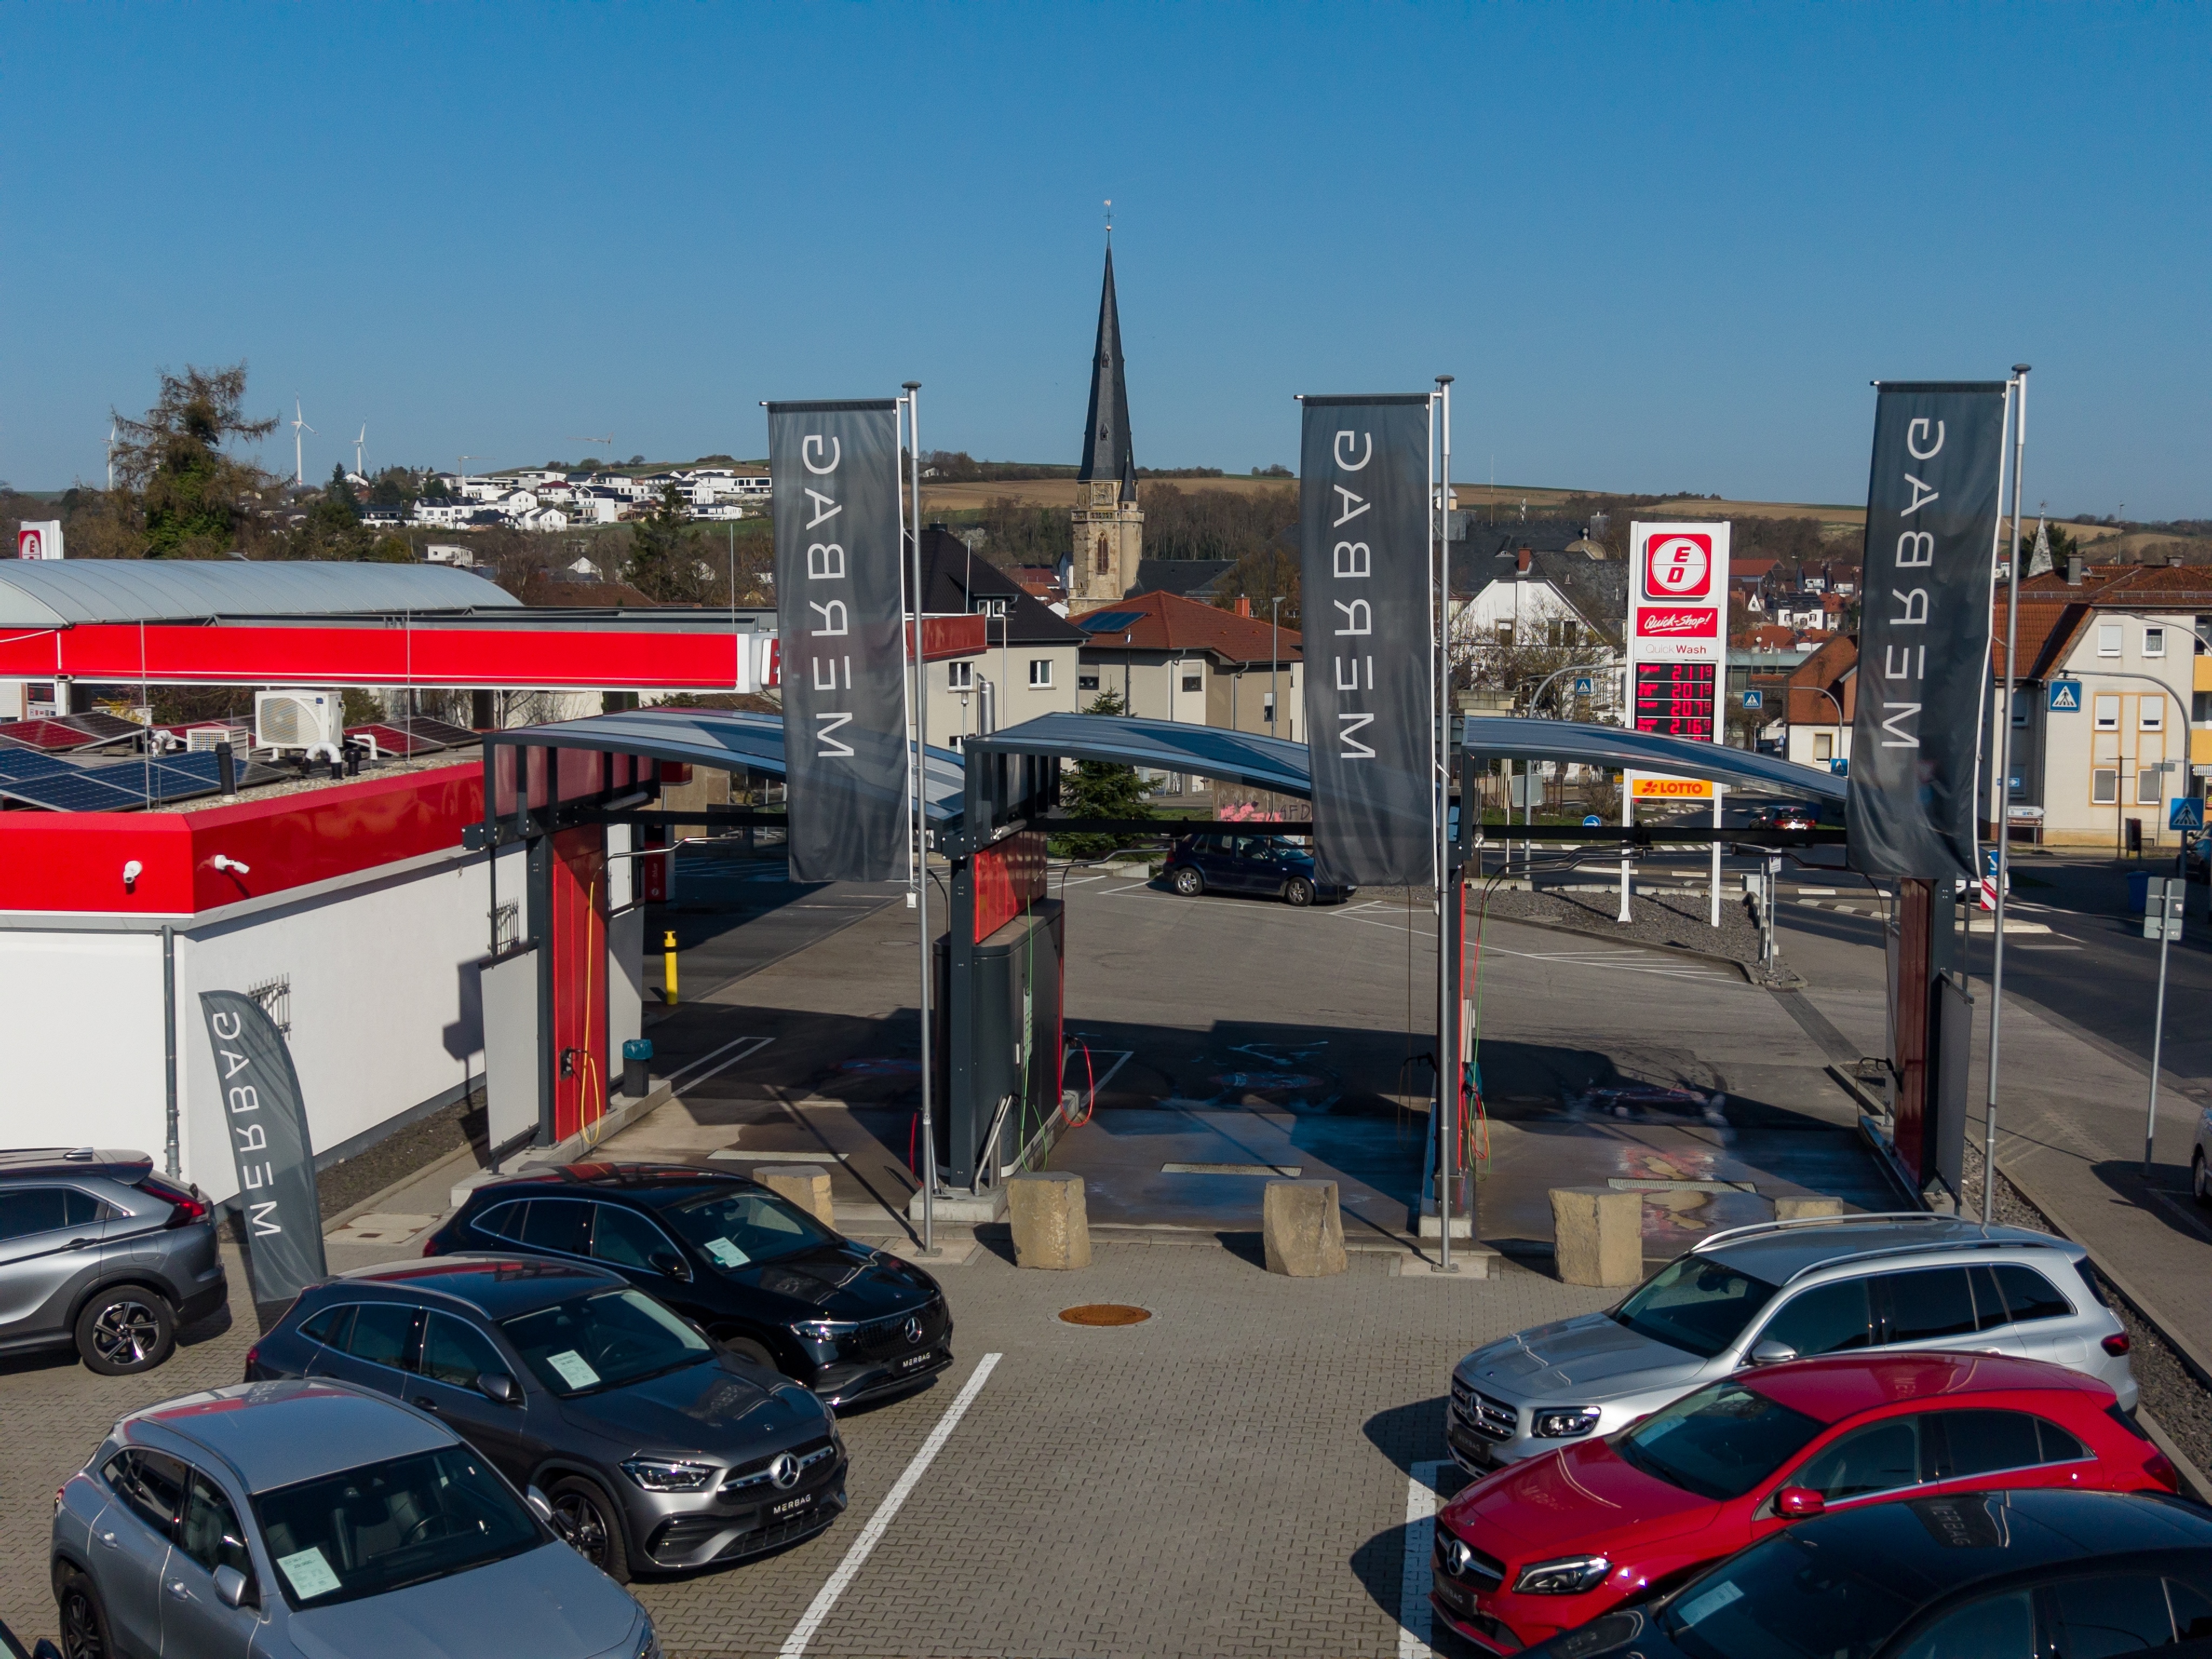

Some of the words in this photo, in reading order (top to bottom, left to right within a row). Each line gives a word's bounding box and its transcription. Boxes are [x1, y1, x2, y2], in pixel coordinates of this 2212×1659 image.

[1644, 612, 1712, 630] Quick-Shop!
[1661, 783, 1702, 794] LOTTO
[773, 1494, 811, 1514] MERBAG
